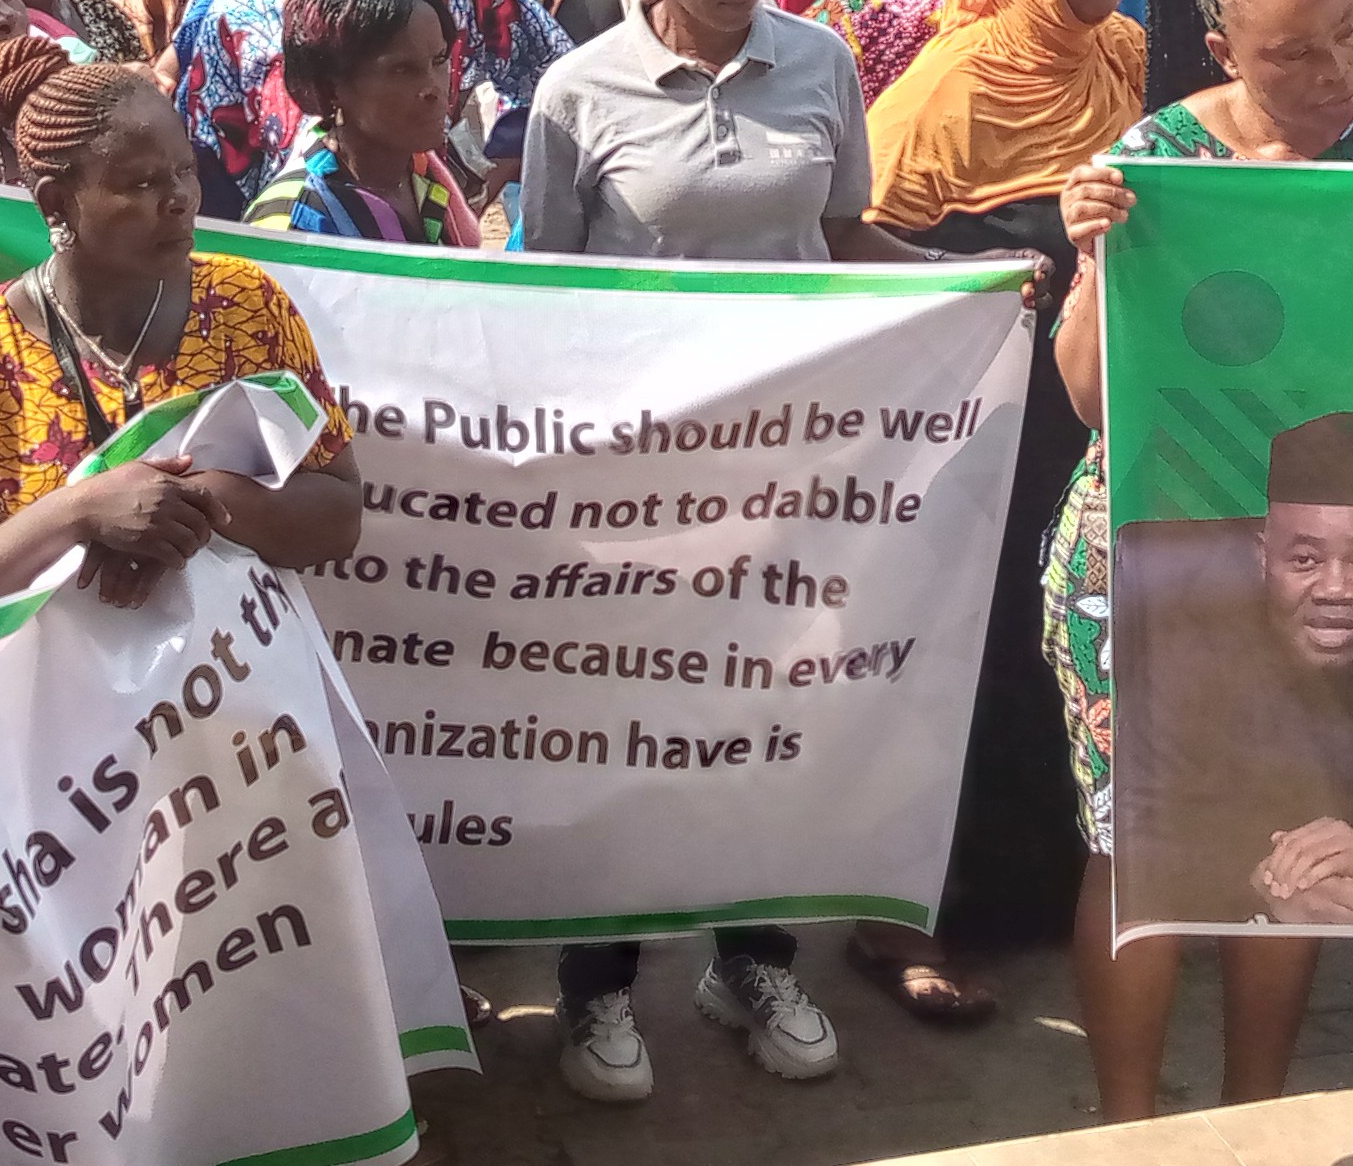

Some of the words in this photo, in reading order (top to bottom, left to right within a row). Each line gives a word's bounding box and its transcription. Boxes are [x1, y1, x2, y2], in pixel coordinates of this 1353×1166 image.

[332, 385, 406, 438] he
[423, 398, 596, 456] Public
[609, 401, 792, 455] should
[803, 400, 865, 444] be
[880, 396, 982, 444] well
[569, 494, 661, 532] not
[675, 489, 729, 528] to
[741, 475, 922, 527] dabble
[404, 554, 497, 600] the
[510, 559, 678, 601] affairs
[692, 555, 751, 600] of
[762, 560, 850, 610] the
[482, 630, 707, 686] because
[724, 642, 772, 690] in
[788, 634, 916, 687] every
[57, 751, 141, 834] is
[134, 627, 252, 759] not
[239, 565, 301, 647] th
[626, 721, 751, 770] have
[765, 723, 803, 763] is
[15, 772, 221, 1023] woman
[232, 713, 308, 787] in
[125, 813, 288, 997] There
[98, 901, 314, 1141] women
